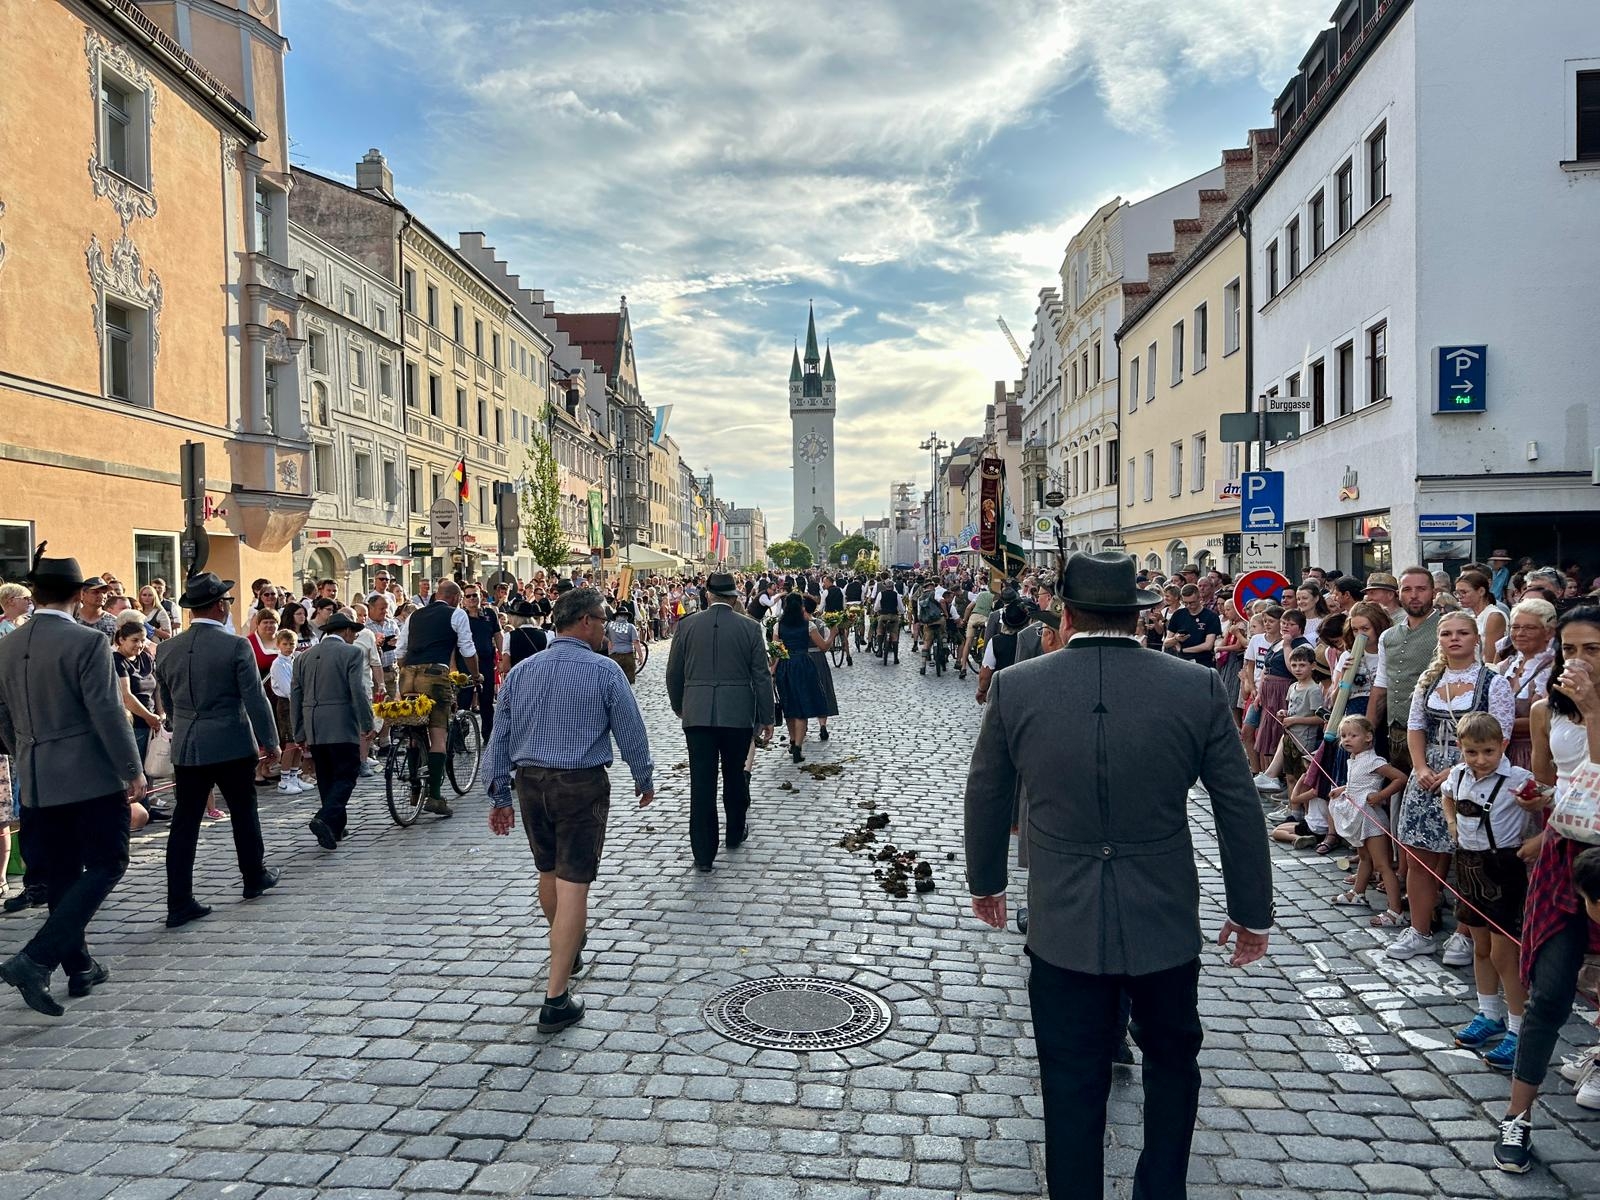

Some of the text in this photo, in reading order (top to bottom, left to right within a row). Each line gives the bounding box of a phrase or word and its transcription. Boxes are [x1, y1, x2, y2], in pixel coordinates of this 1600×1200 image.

[1455, 356, 1472, 377] P
[1270, 399, 1311, 412] Burggasse
[1455, 395, 1471, 404] frei
[1223, 483, 1241, 494] dm
[1248, 475, 1267, 500] P
